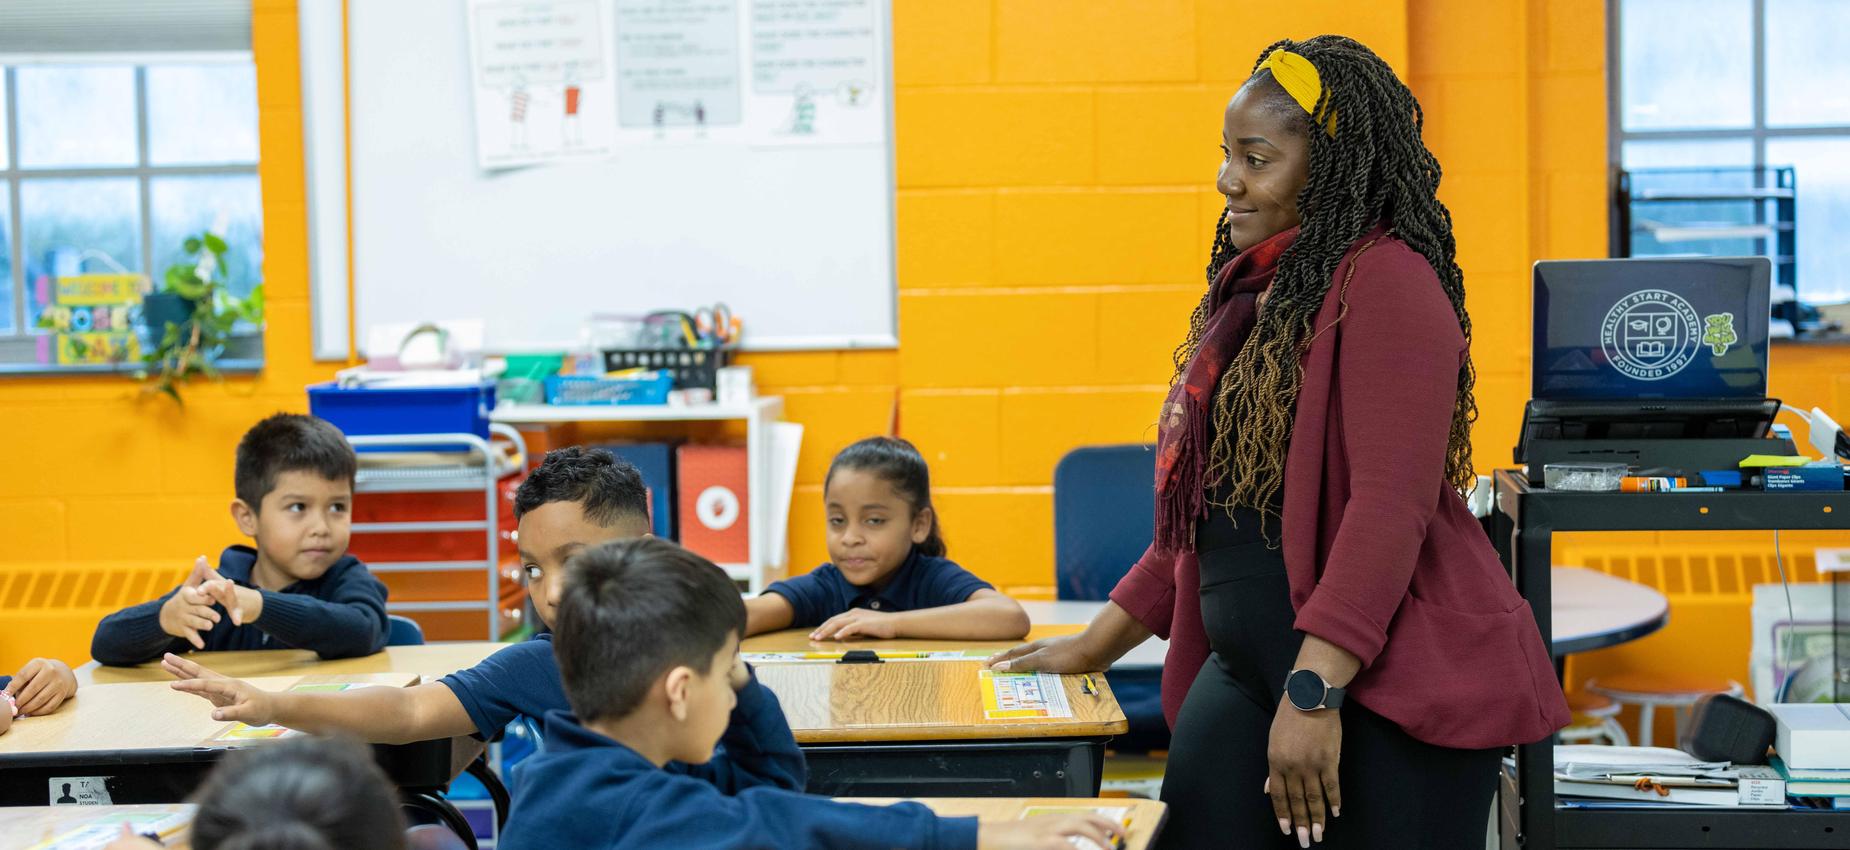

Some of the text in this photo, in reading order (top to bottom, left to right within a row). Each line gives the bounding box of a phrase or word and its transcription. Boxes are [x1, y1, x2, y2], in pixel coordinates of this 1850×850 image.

[1604, 292, 1698, 344] HEALTHY START ACADEMY
[1612, 353, 1688, 377] FOUNDED 1997
